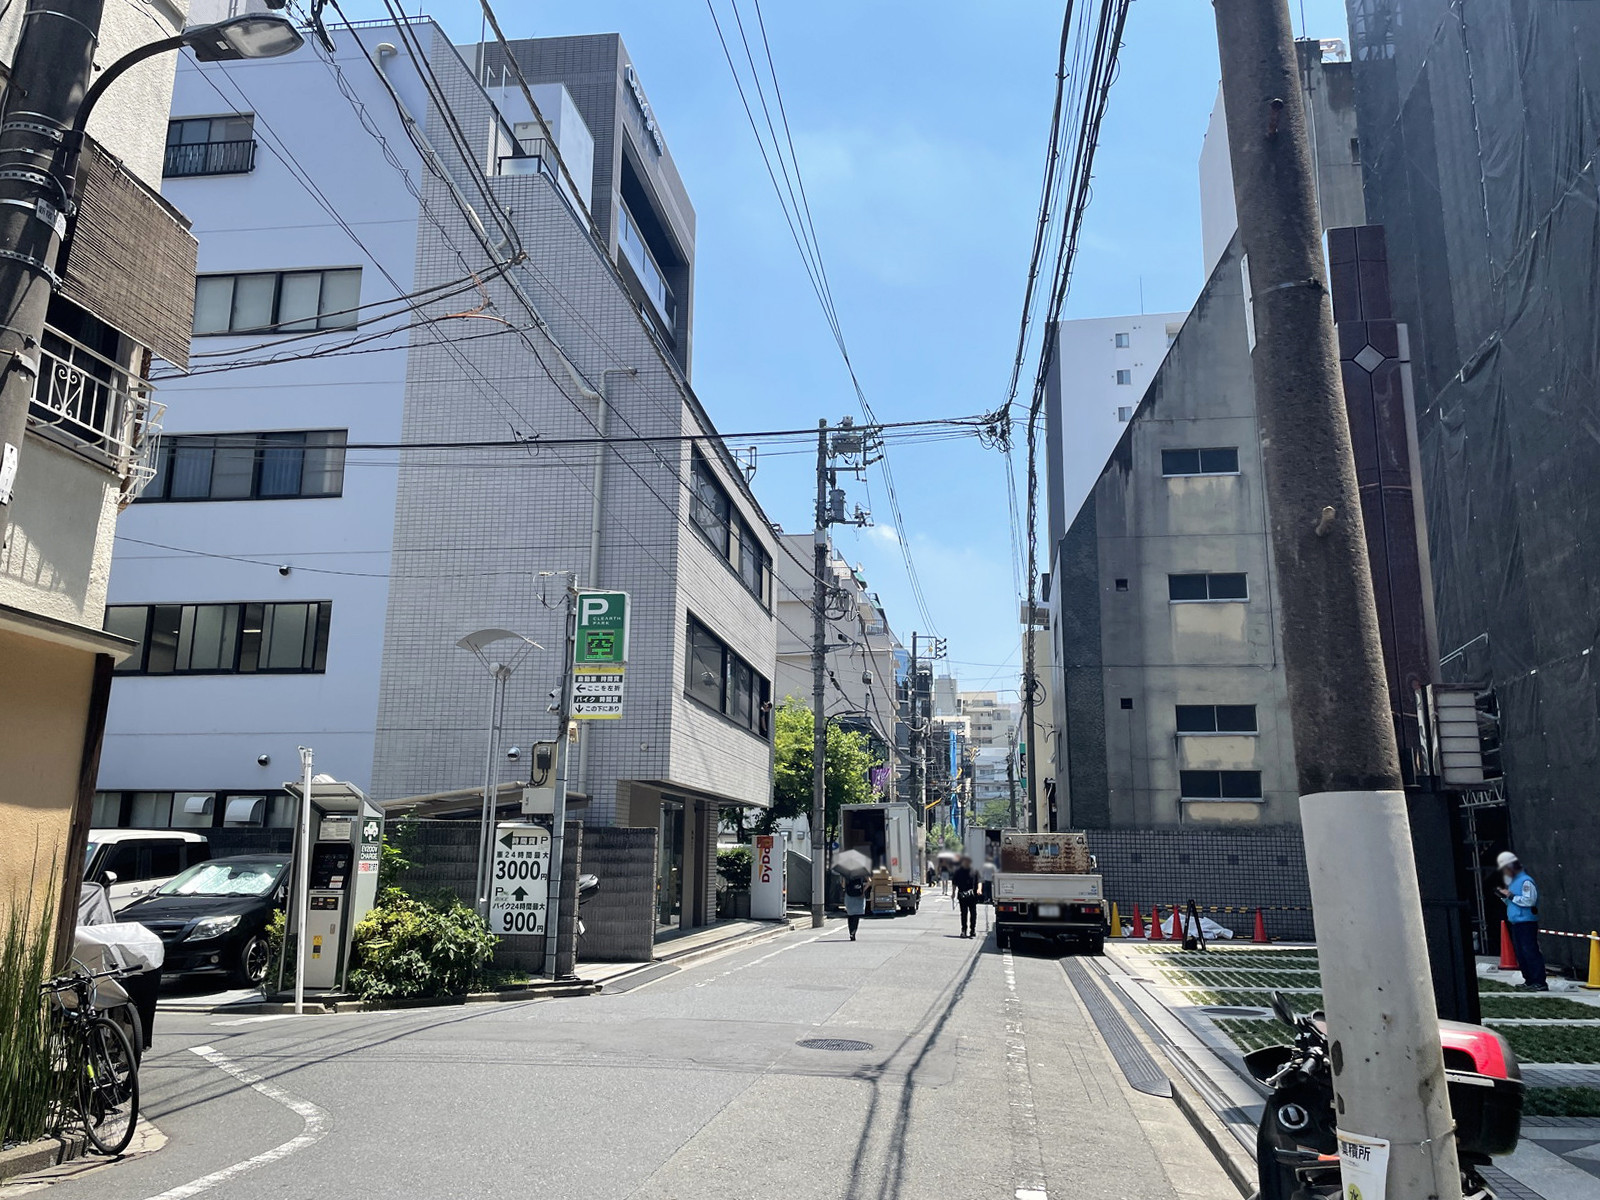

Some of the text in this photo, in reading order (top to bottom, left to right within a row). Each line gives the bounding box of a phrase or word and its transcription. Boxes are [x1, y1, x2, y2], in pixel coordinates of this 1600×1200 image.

[581, 598, 609, 626] P
[586, 632, 614, 659] 空
[540, 836, 549, 845] P
[360, 852, 378, 860] CHARGE
[495, 860, 548, 881] 3000円
[495, 887, 504, 897] P
[492, 902, 546, 910] バイク24時間最大
[503, 911, 544, 933] 900円
